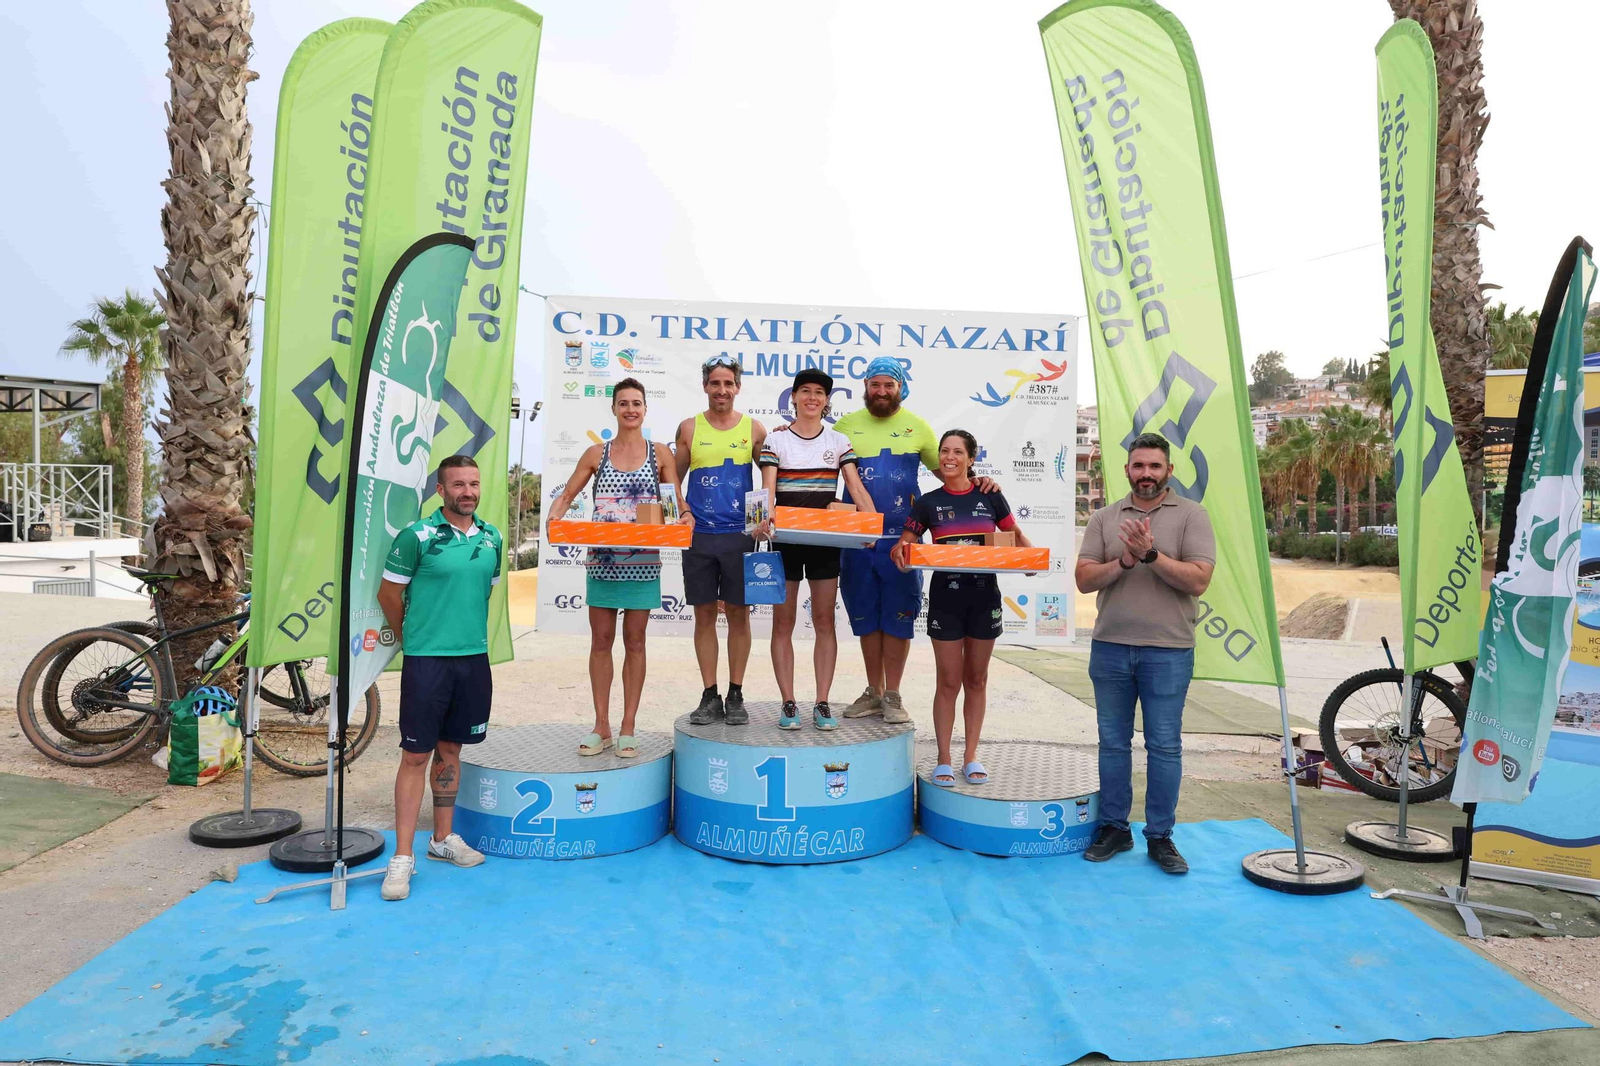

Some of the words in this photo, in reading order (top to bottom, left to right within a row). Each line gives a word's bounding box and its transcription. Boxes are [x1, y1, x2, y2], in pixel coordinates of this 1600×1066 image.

[472, 71, 517, 270] Granada
[382, 281, 404, 350] Triatlón
[468, 284, 500, 342] de
[552, 310, 638, 338] C.D.
[651, 314, 885, 346] TRIATLÓN
[899, 322, 1069, 352] NAZARÍ
[379, 351, 390, 376] de
[718, 348, 913, 382] LMUÑÉCR
[1028, 384, 1058, 395] #387#
[366, 380, 387, 474] Andaluza
[1012, 460, 1045, 468] TORRES
[554, 594, 582, 609] GC
[1483, 743, 1494, 752] You
[511, 778, 556, 836] 2
[753, 755, 796, 822] 1
[696, 821, 865, 858] ALMUÑÉCAR
[1039, 802, 1067, 840] 3
[477, 836, 596, 857] ALMUÑÉCAR
[1009, 836, 1091, 855] ALMUÑÉCAR
